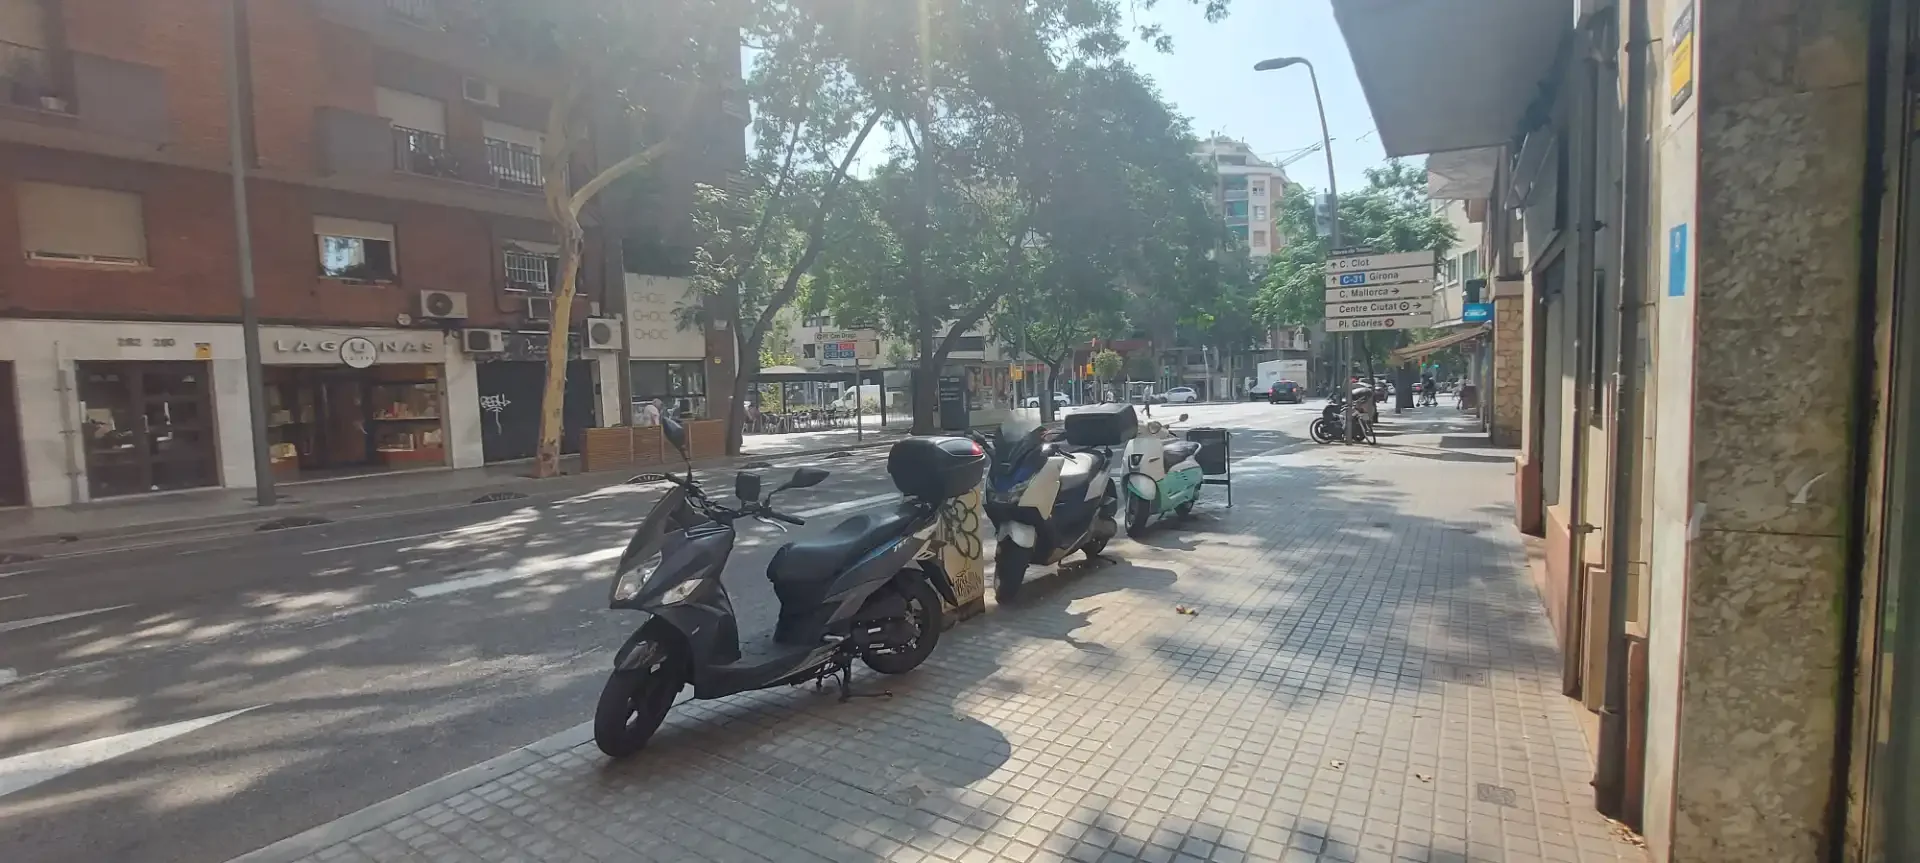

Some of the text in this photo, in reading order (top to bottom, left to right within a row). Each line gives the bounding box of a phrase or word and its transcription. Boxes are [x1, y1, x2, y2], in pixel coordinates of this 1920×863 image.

[1352, 259, 1369, 267] Clot
[1343, 272, 1399, 284] C-31 Girona
[1340, 288, 1389, 298] C. Mallorca
[1339, 302, 1397, 313] Centre Ciutat
[1352, 318, 1383, 327] Glòries
[274, 339, 433, 354] LAGUNAS
